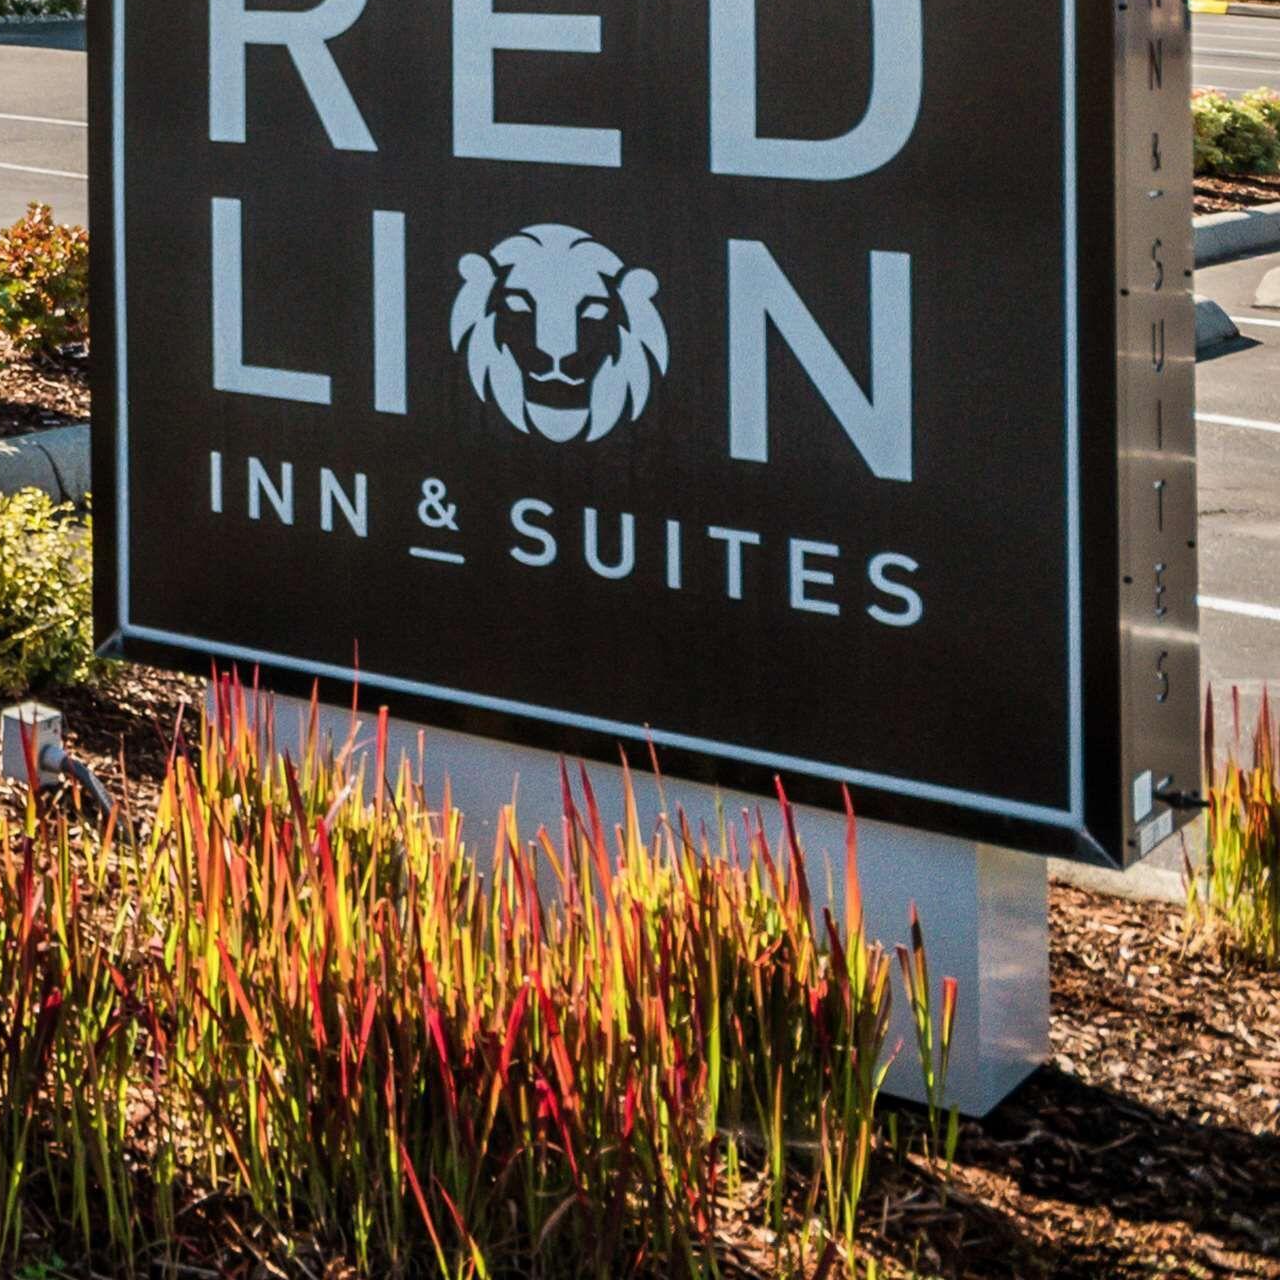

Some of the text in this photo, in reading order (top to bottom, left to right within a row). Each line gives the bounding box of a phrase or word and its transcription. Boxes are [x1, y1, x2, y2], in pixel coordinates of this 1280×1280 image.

[209, 449, 925, 628] INN & SUITES
